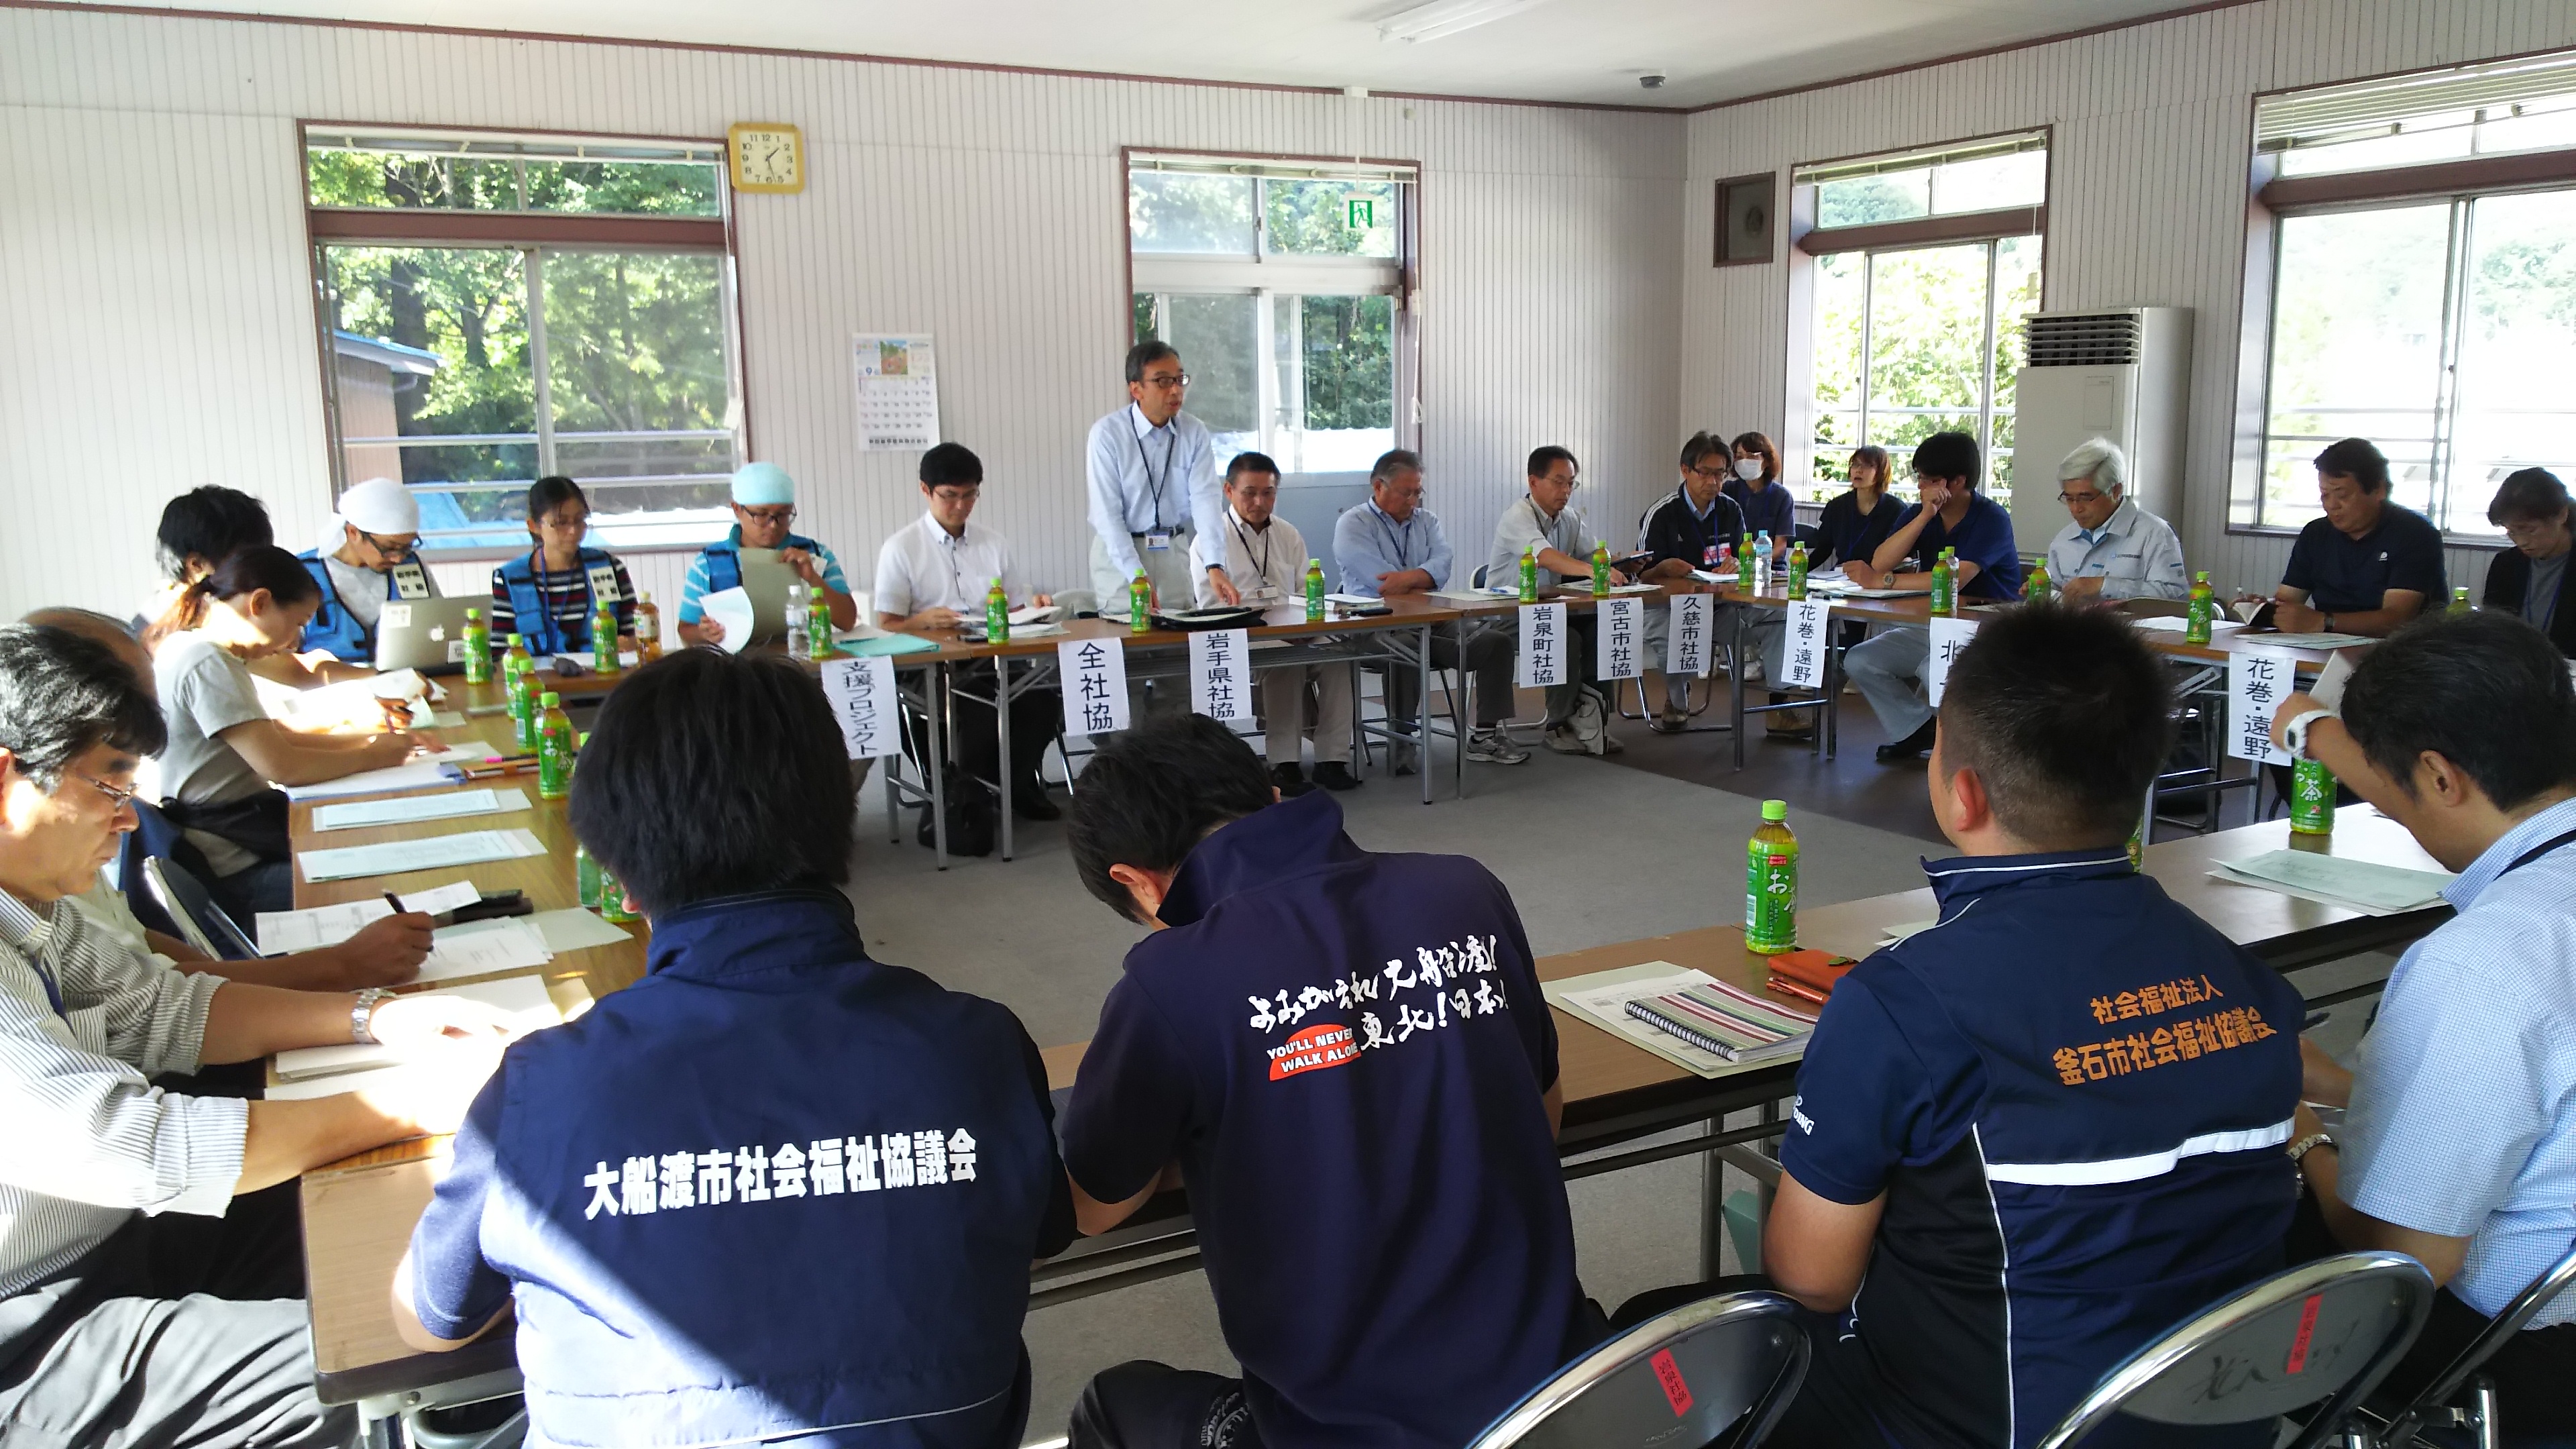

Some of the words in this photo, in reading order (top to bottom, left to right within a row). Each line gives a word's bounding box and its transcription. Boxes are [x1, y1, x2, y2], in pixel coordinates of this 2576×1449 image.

[755, 174, 760, 182] 7
[776, 135, 780, 143] 1
[784, 143, 790, 151] 2
[1532, 606, 1554, 684] 岩泉町社協
[1610, 600, 1631, 678] 宮古市社協
[1679, 596, 1701, 671] 久慈市社協
[1792, 604, 1817, 683] 花巻・遠野
[1078, 642, 1112, 731] 全社協
[1206, 633, 1235, 720] 岩手県社協
[2244, 658, 2275, 759] 花巻・遠野
[2090, 974, 2224, 1025] 社会福祉法人
[1267, 1038, 1313, 1060] YOU'LL
[1315, 1028, 1352, 1047] NEVER
[1281, 1051, 1323, 1073] WALK
[1327, 1041, 1358, 1062] ALONE
[2052, 1006, 2277, 1086] 釜石市社会福祉協議会
[584, 1128, 977, 1220] 大船渡市社会福祉協議会
